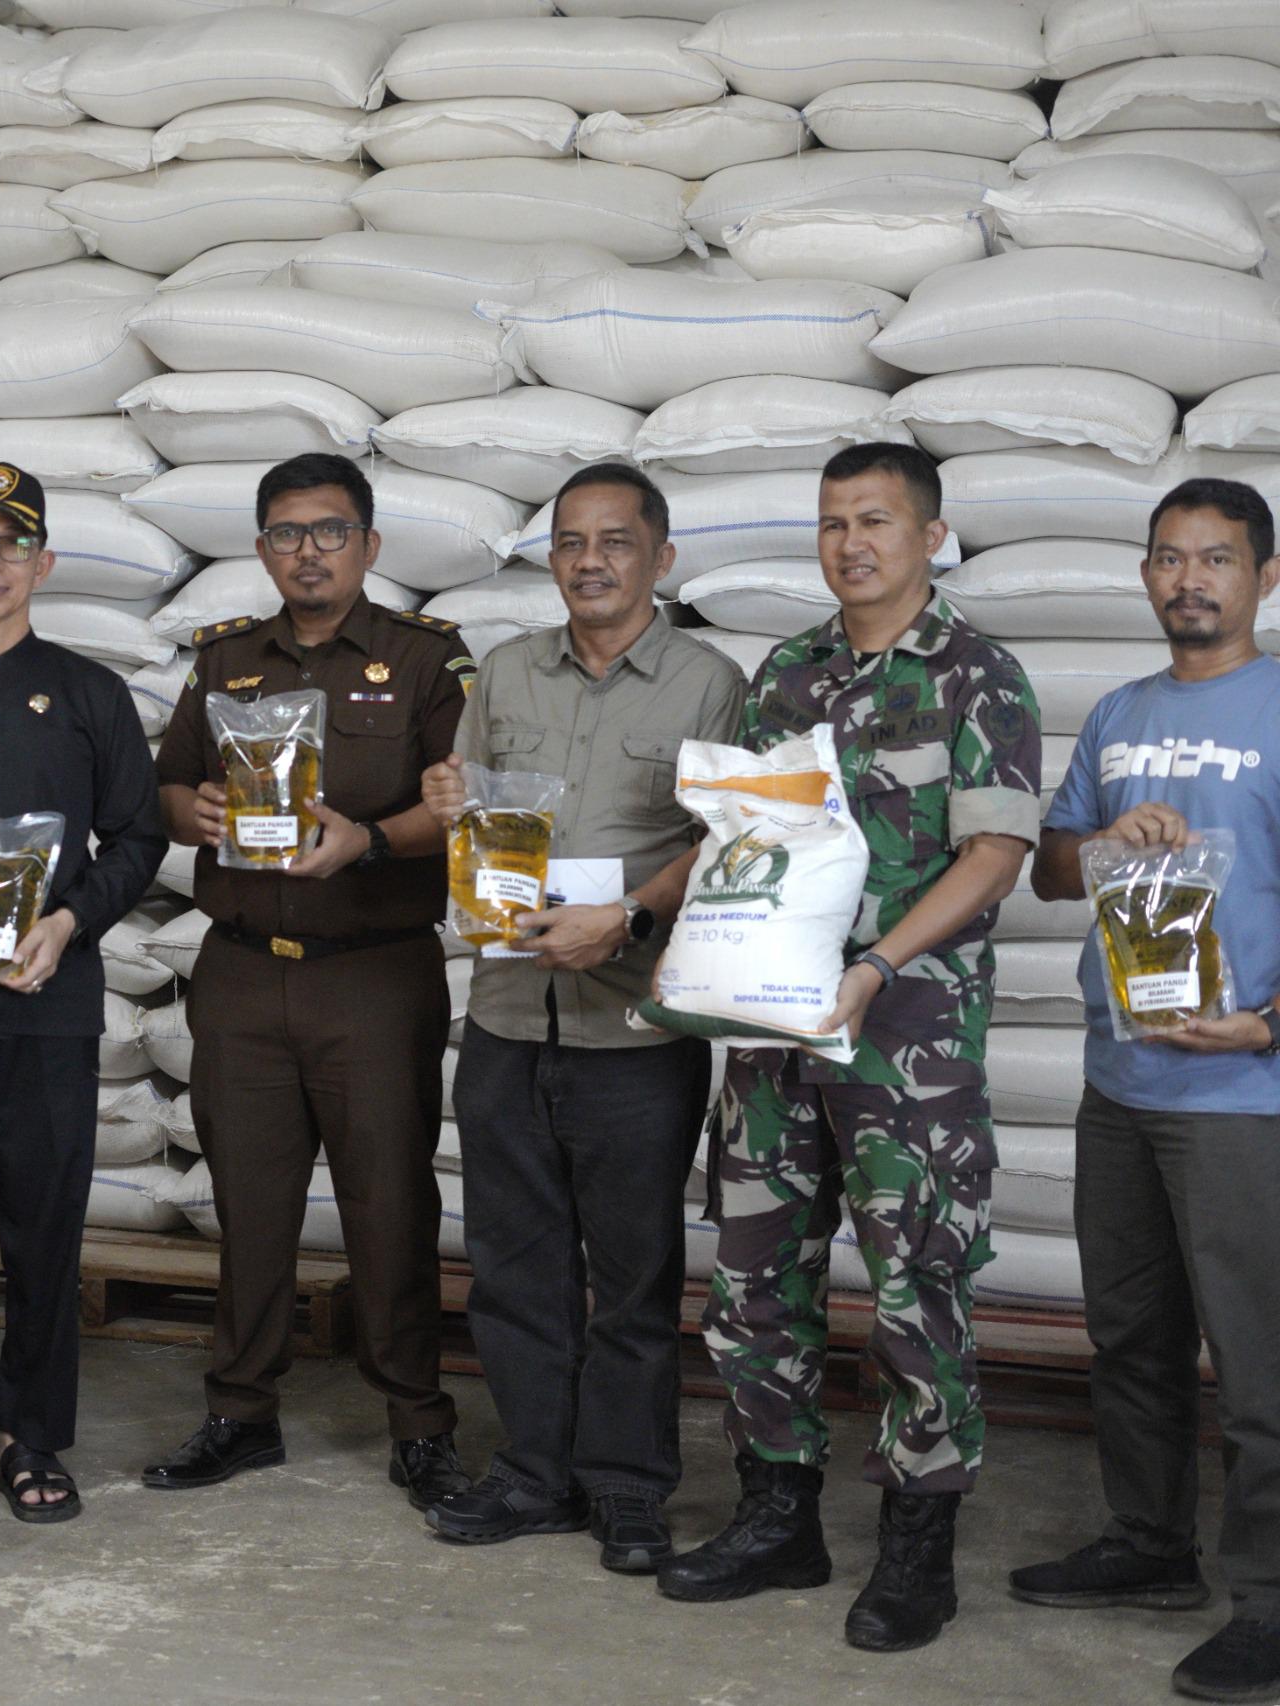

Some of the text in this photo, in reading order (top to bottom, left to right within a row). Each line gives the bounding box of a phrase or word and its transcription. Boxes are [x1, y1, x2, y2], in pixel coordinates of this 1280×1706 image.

[906, 714, 938, 735] AD
[482, 873, 513, 883] BNTUAN
[733, 877, 784, 895] PANGAN
[685, 911, 768, 922] BERAS MEDIUM
[722, 927, 745, 945] kg
[760, 983, 822, 995] TIDAK UNTUK
[1131, 979, 1189, 992] BANTUAN PANGA
[733, 994, 823, 1006] DIPERJUALBELIKAN
